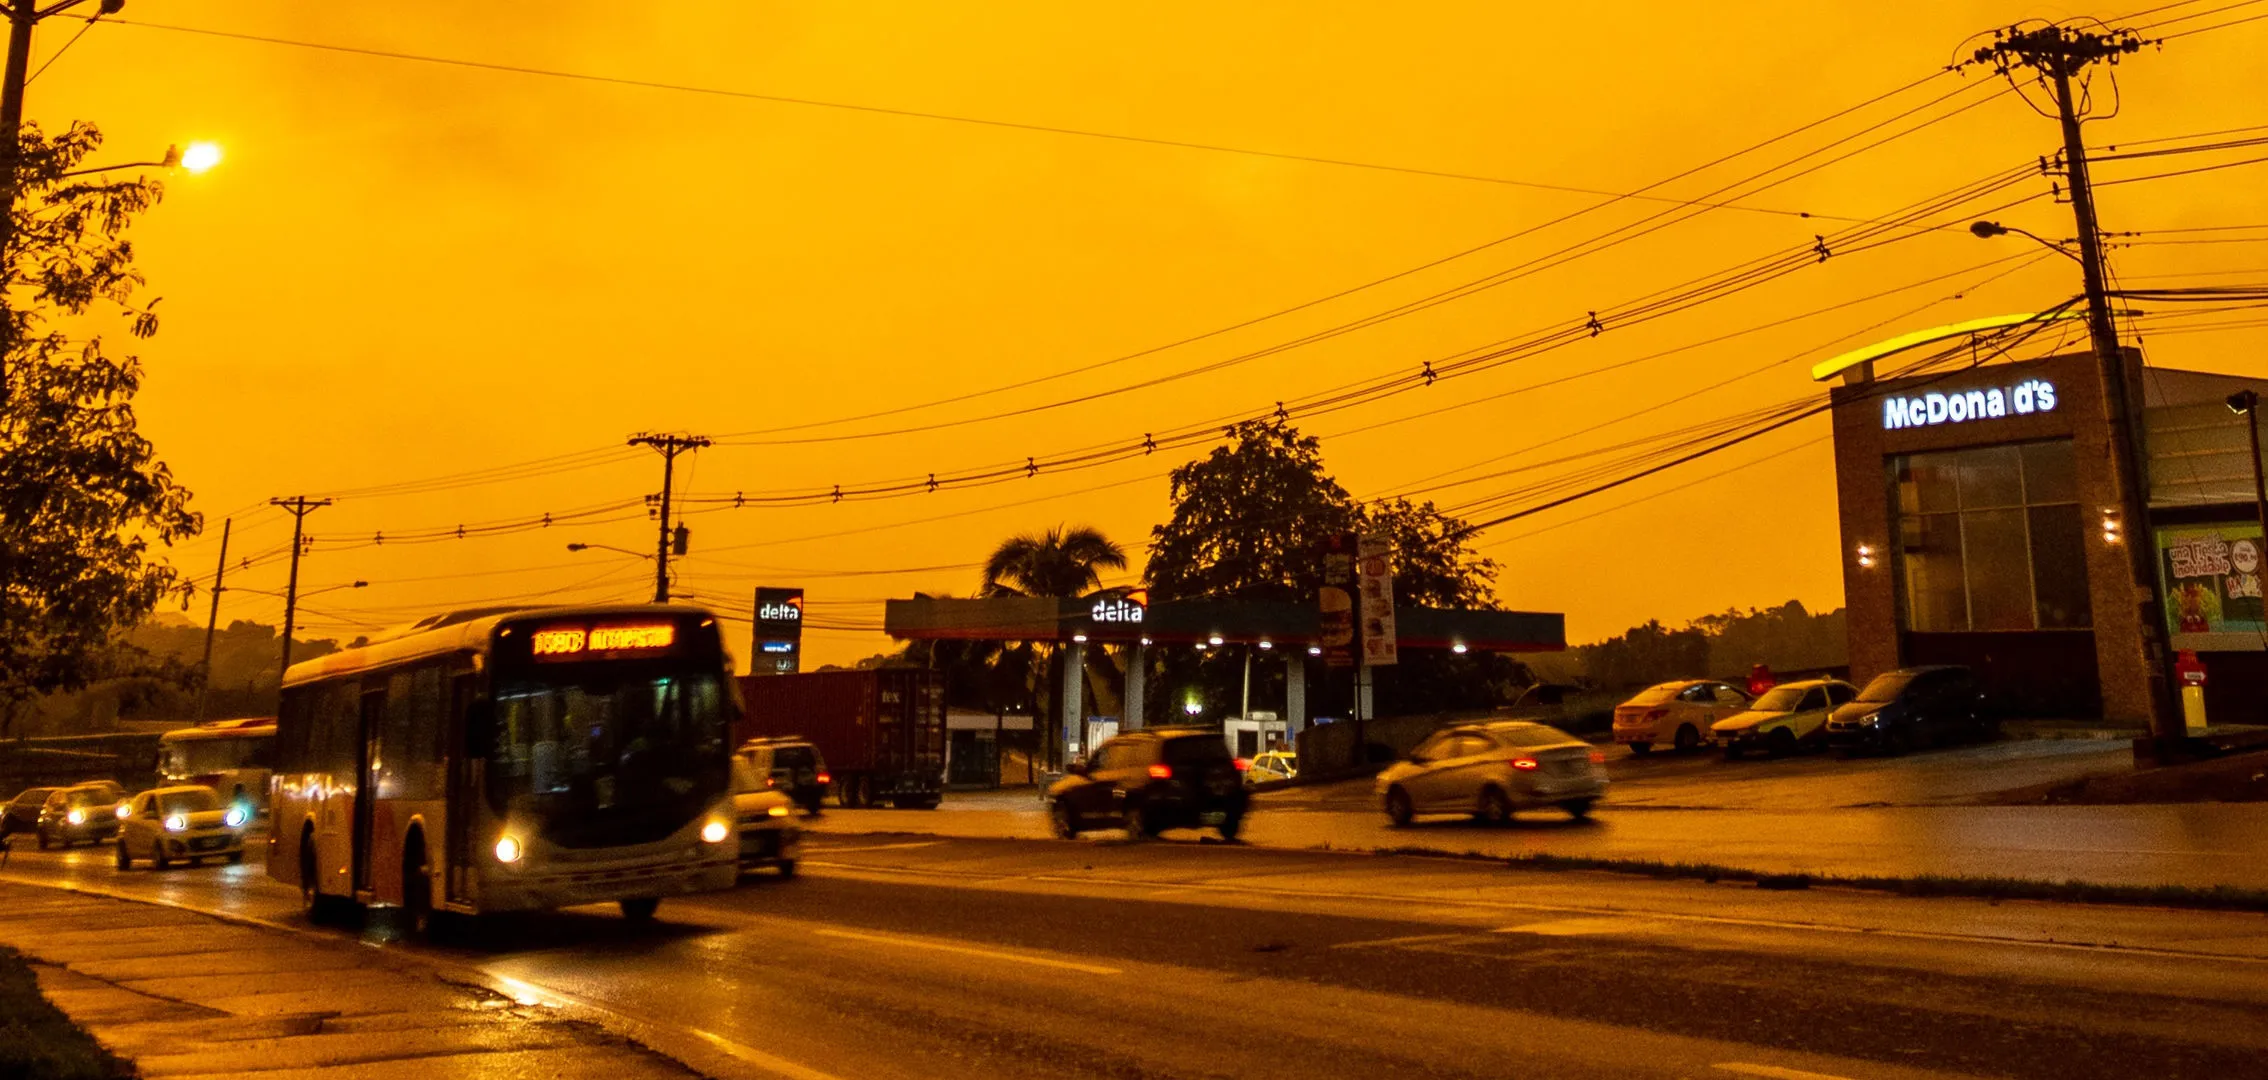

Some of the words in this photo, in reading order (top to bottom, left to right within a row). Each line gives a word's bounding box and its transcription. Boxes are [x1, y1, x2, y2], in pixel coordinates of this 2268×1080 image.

[1884, 380, 2056, 429] McDonald's
[760, 603, 799, 620] delta
[1092, 600, 1143, 623] delta
